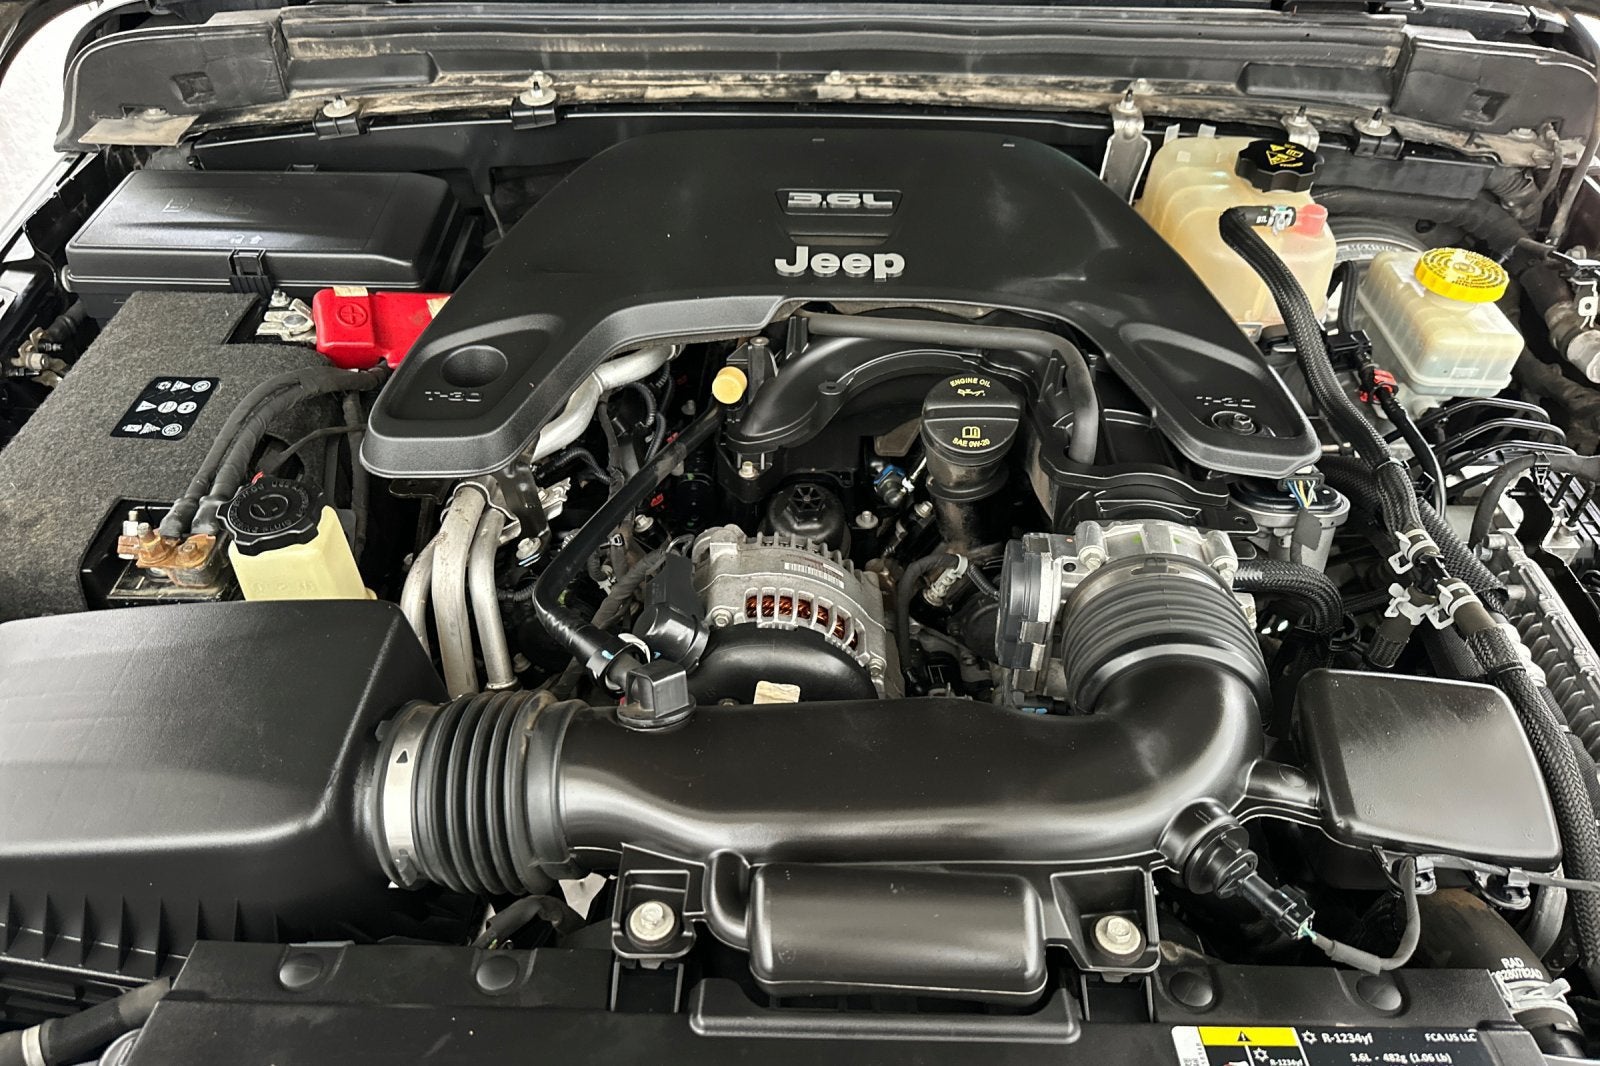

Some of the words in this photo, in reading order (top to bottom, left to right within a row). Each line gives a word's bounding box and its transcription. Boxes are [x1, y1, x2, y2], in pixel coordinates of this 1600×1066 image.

[787, 192, 893, 209] 3.6L
[774, 246, 906, 282] Jeep
[950, 378, 978, 387] ENGINE
[979, 379, 991, 388] OIL
[952, 437, 968, 447] SAE
[1500, 956, 1525, 969] RAD
[1321, 1032, 1373, 1046] R-1234yf
[1424, 1032, 1445, 1042] FCA
[1444, 1033, 1460, 1042] US
[1459, 1033, 1478, 1042] LLC
[1350, 1052, 1372, 1062] 3.6L
[1383, 1052, 1408, 1064] 482g
